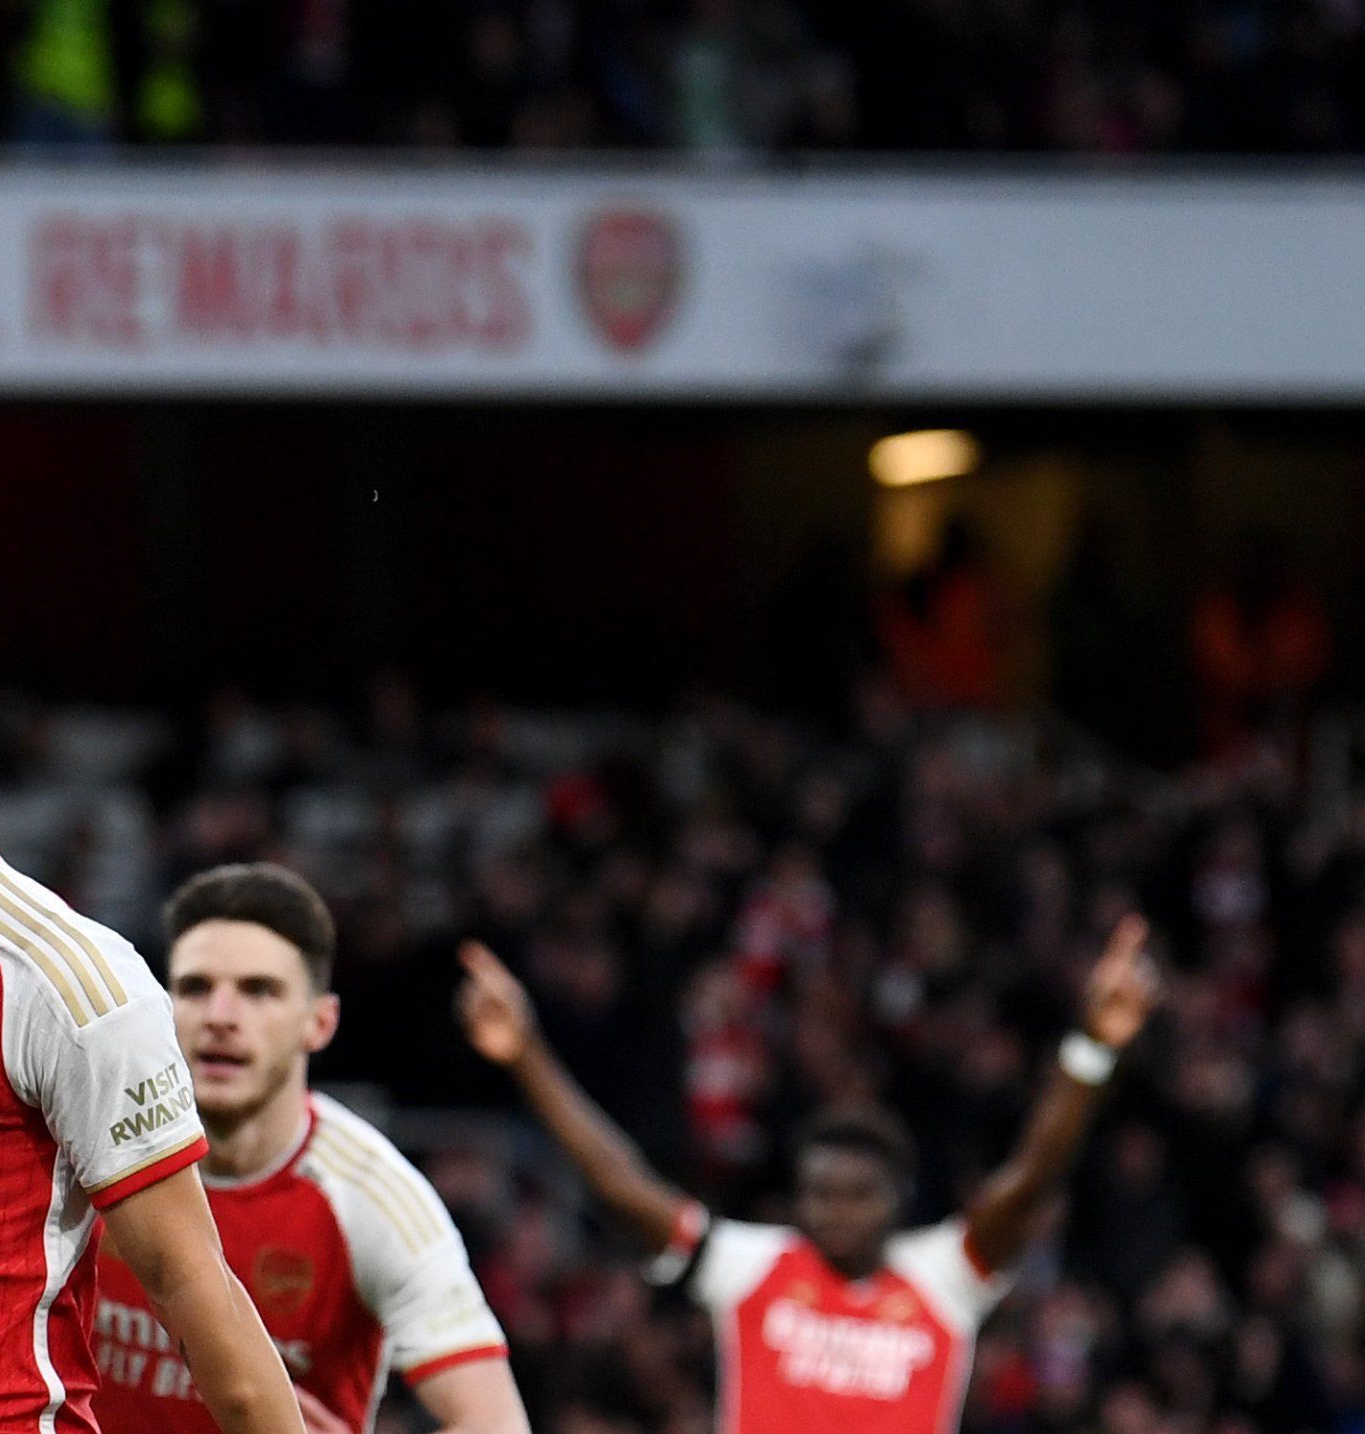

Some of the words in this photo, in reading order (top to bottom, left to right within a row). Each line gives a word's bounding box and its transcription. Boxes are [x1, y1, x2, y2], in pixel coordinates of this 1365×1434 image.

[27, 207, 537, 348] REWARDS
[124, 1063, 180, 1106] VISIT
[110, 1086, 193, 1146] RWAND
